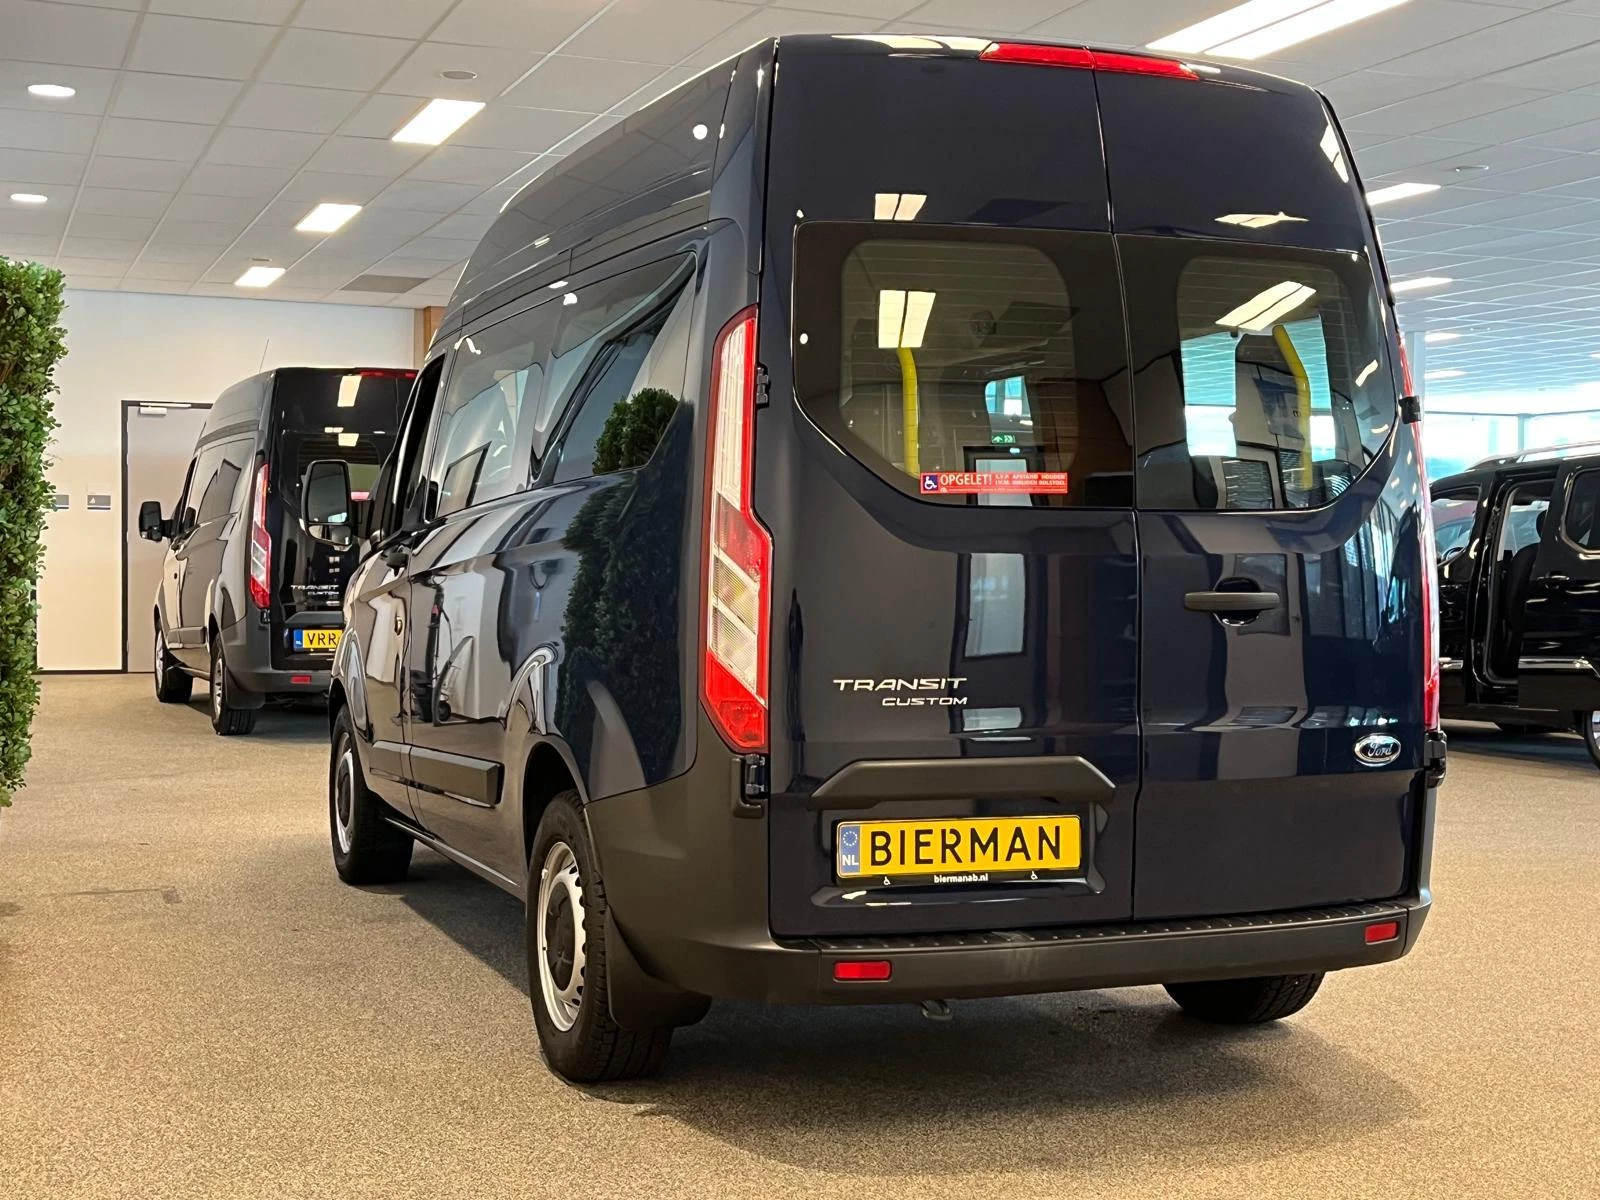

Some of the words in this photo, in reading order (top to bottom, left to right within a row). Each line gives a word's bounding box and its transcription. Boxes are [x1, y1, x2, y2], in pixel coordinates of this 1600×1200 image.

[939, 473, 992, 486] OPGELET!
[833, 677, 967, 691] TRANSIT
[882, 697, 968, 706] CUSTOM
[1367, 742, 1394, 757] Ford
[842, 854, 859, 867] NL
[870, 825, 1061, 867] BIERMAN
[933, 873, 989, 884] biermanab.nl
